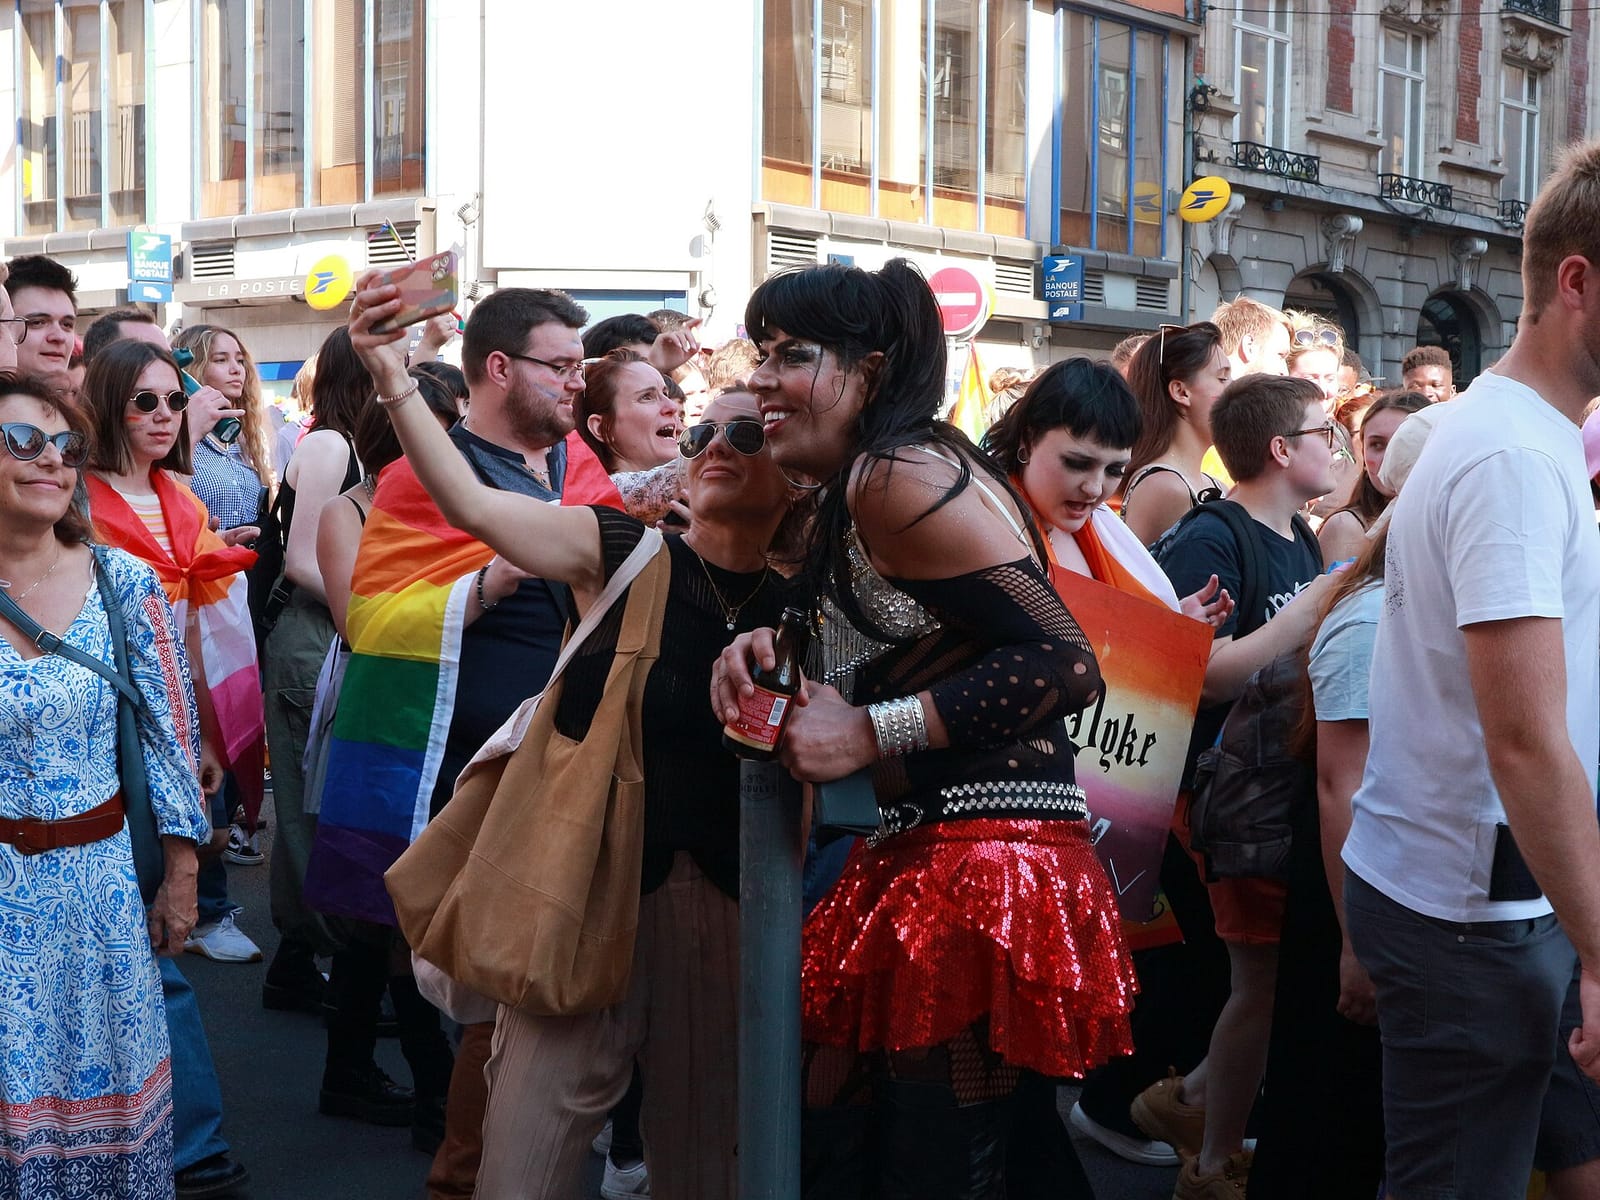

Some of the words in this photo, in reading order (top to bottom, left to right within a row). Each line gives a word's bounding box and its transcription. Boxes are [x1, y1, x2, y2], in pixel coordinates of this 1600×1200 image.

[134, 252, 146, 260] LA
[134, 260, 169, 270] BANQUE
[134, 269, 169, 279] POSTALE
[1045, 274, 1056, 282] LA
[207, 284, 229, 297] LA
[240, 279, 300, 294] POSTE
[1045, 281, 1078, 291] BANQUE
[1045, 290, 1078, 298] POSTALE
